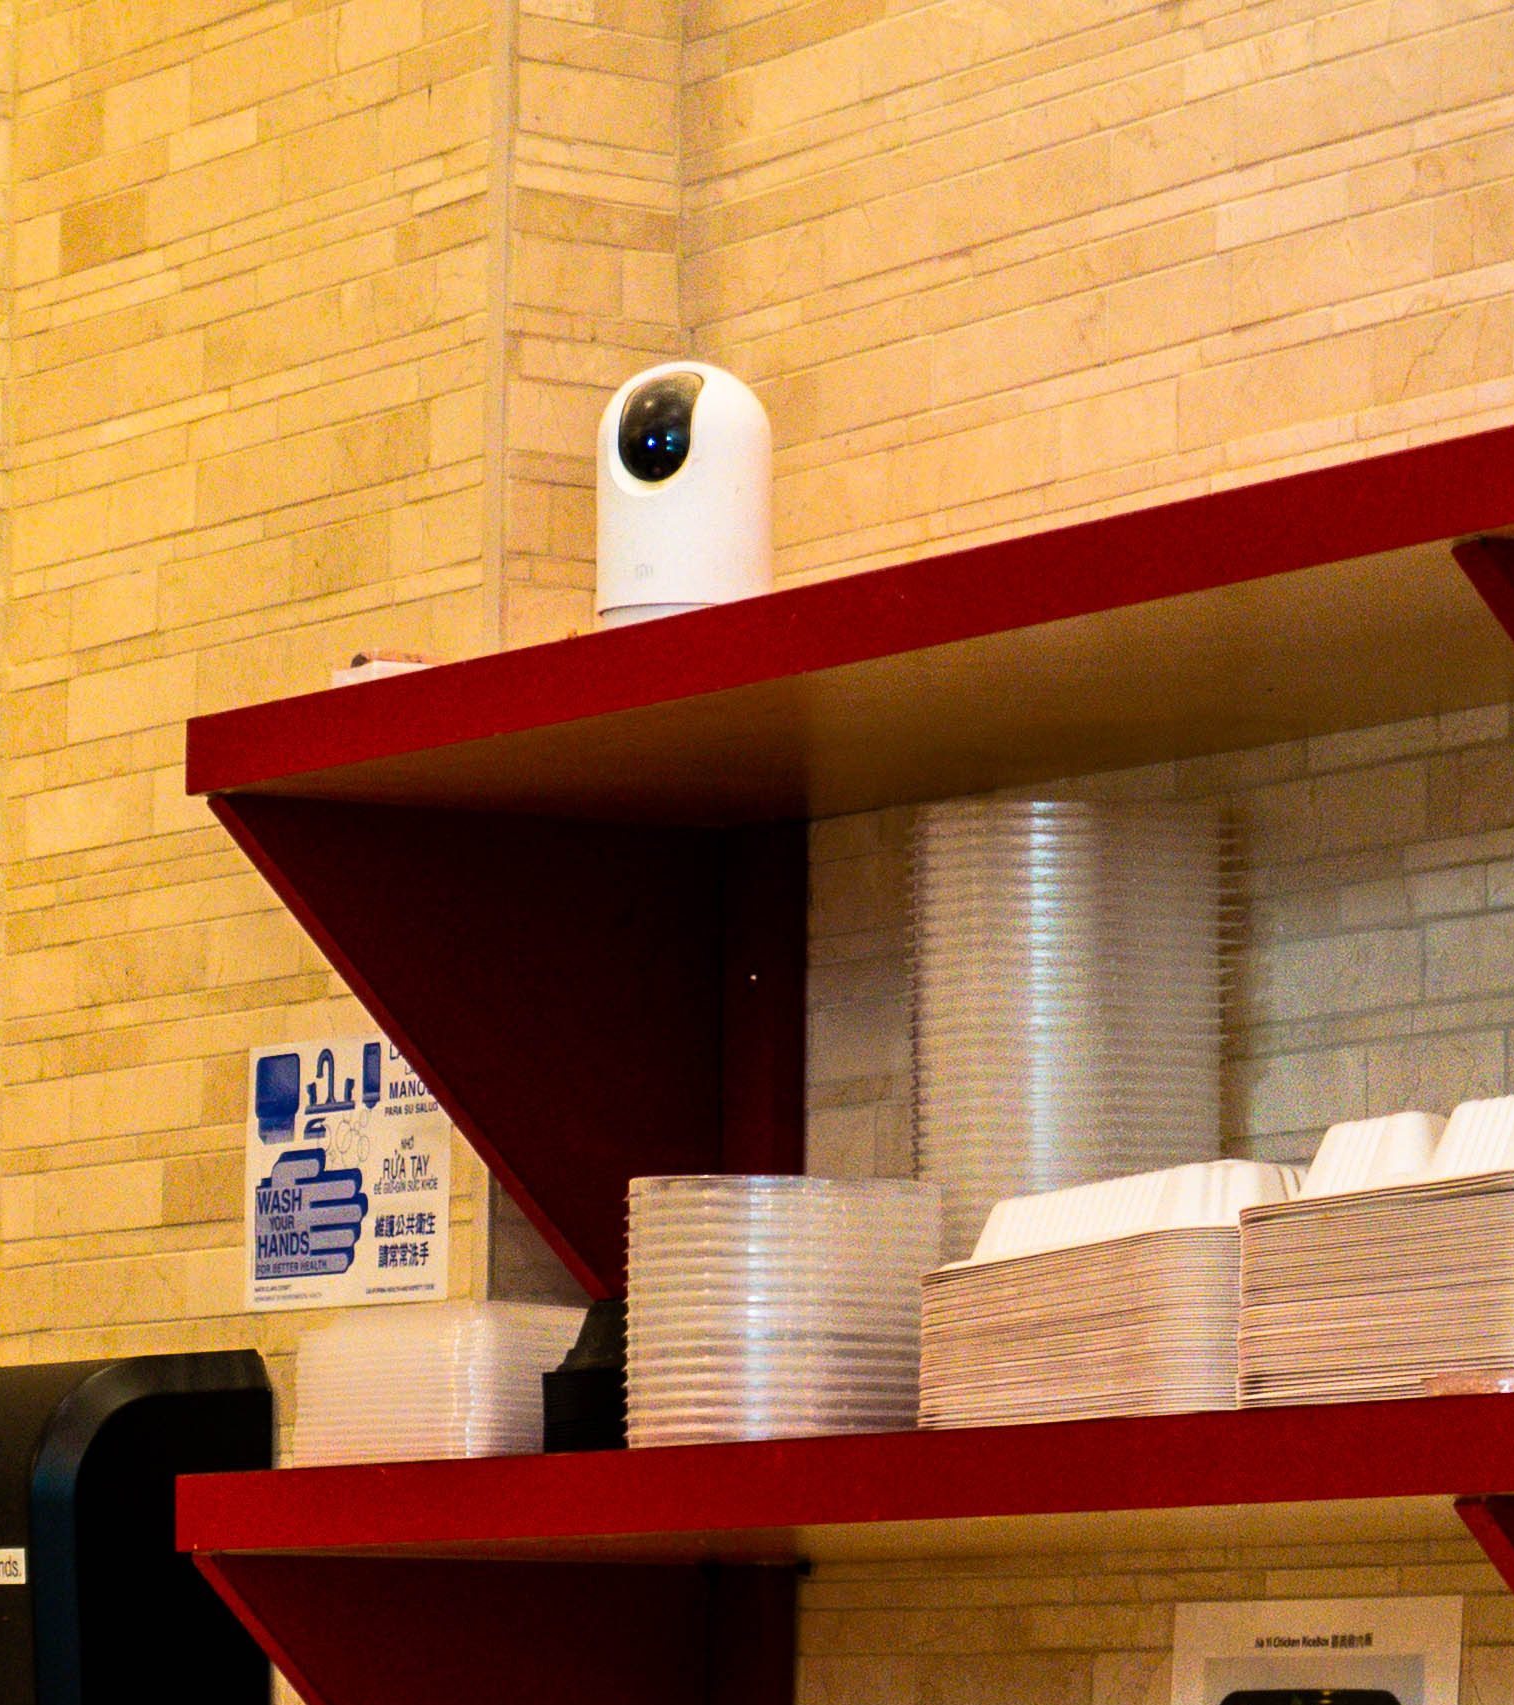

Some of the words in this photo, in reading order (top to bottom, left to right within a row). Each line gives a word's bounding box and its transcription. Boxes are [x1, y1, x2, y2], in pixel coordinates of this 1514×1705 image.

[410, 1154, 430, 1178] TAY
[257, 1188, 302, 1215] WASH
[269, 1215, 295, 1231] YOUR
[257, 1231, 310, 1258] HANDS
[257, 1264, 271, 1274] FOR
[272, 1262, 299, 1273] BETTER
[300, 1260, 327, 1272] HEALTH
[1273, 1635, 1300, 1648] Chicken
